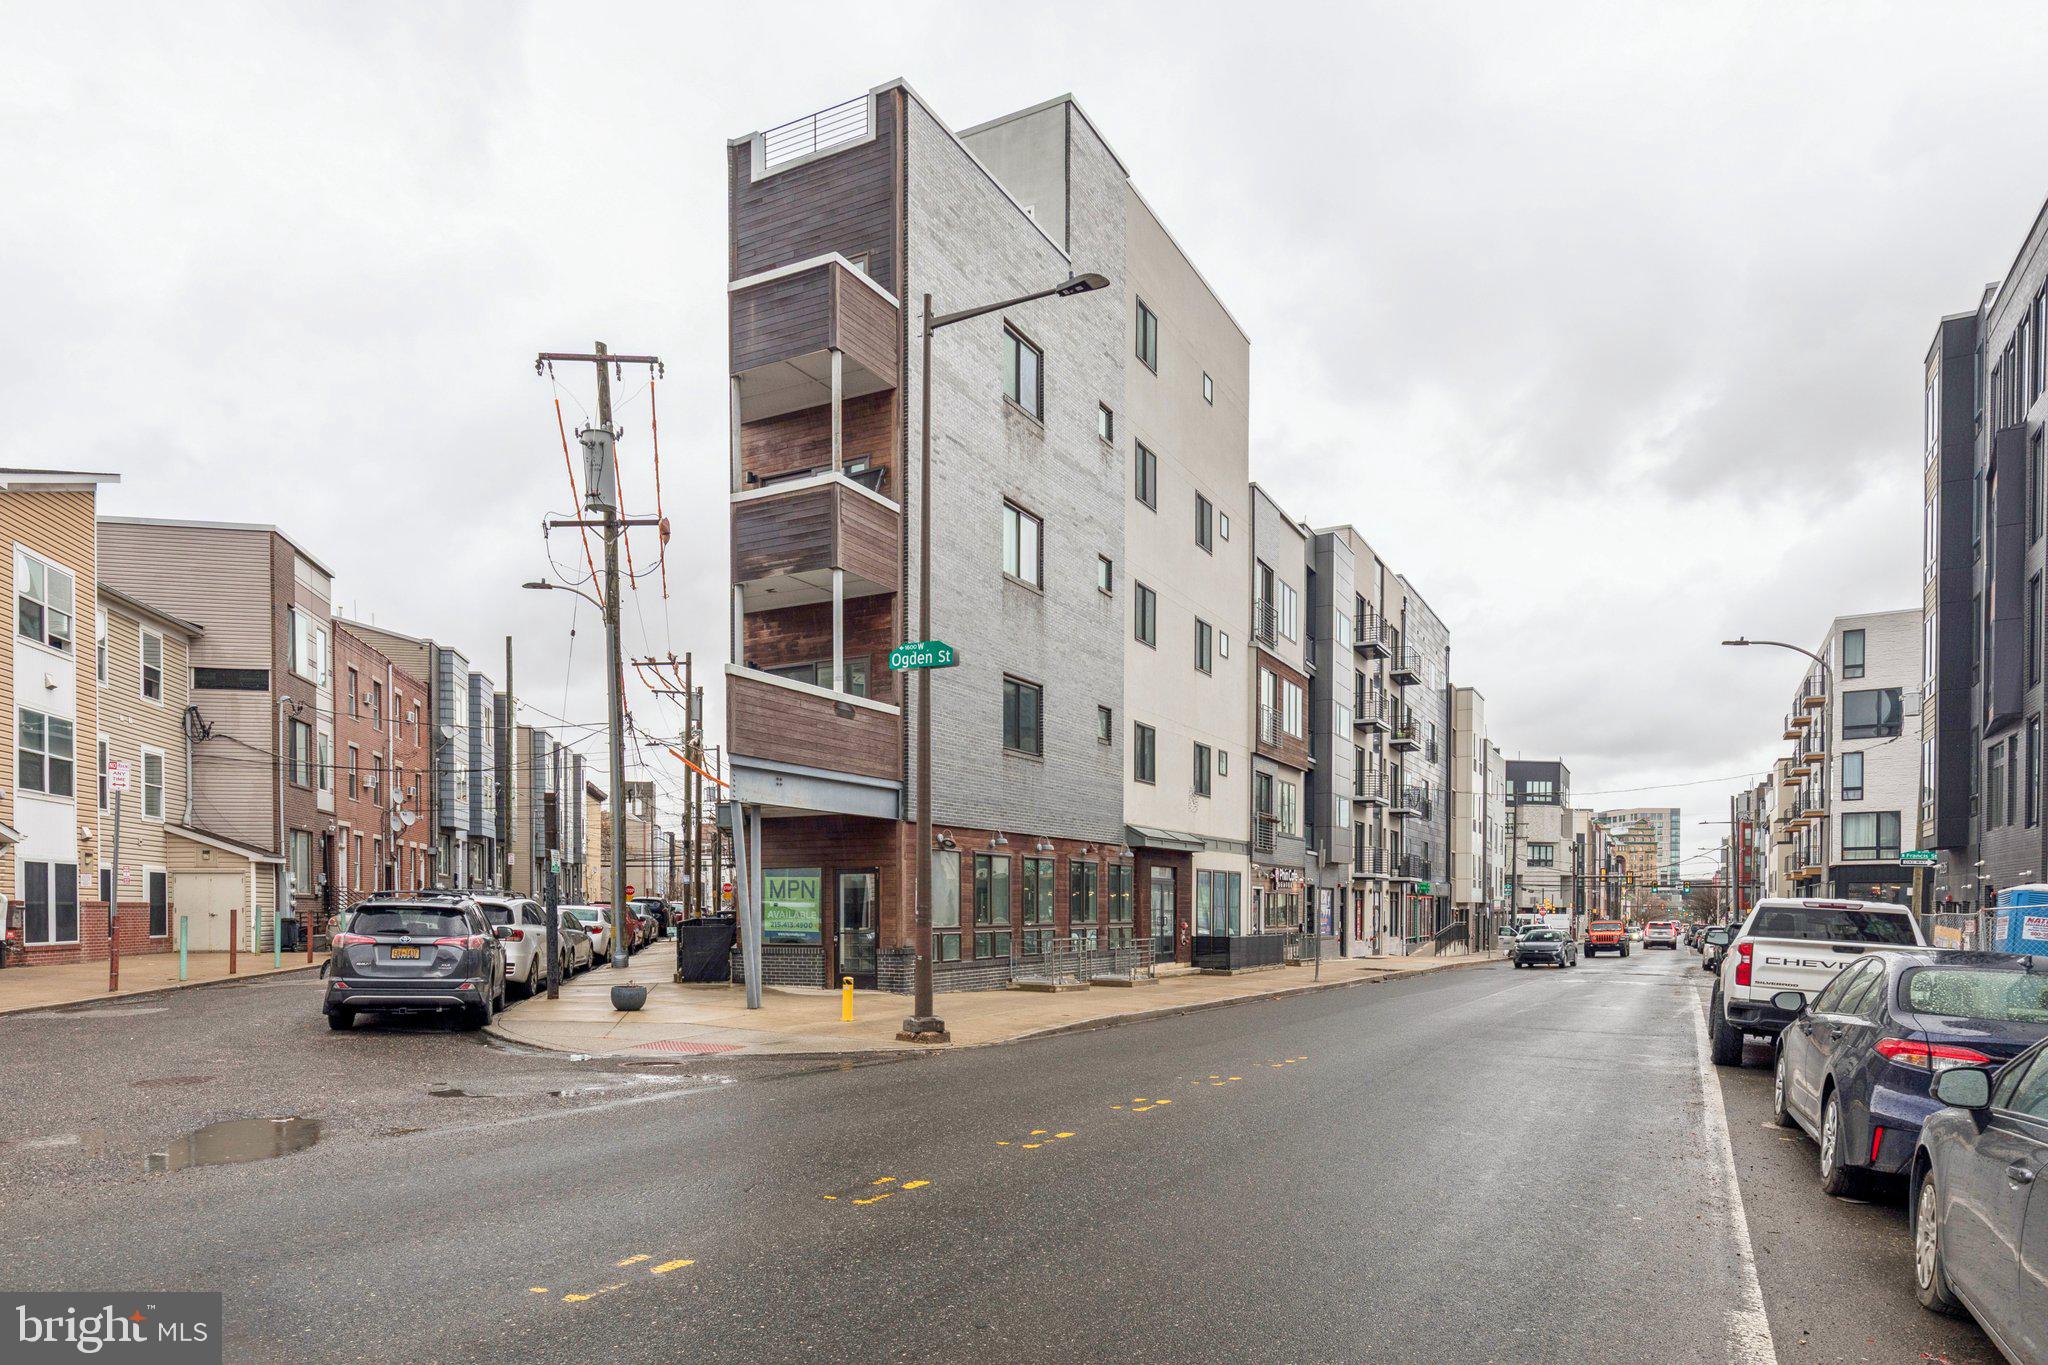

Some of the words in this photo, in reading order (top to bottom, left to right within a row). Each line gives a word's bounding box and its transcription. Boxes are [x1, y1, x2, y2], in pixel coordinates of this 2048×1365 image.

[891, 650, 933, 668] Ogden
[938, 649, 951, 663] St
[769, 879, 816, 899] MPN
[767, 909, 817, 919] AVAILABLE
[1754, 980, 1799, 988] SILVERADO
